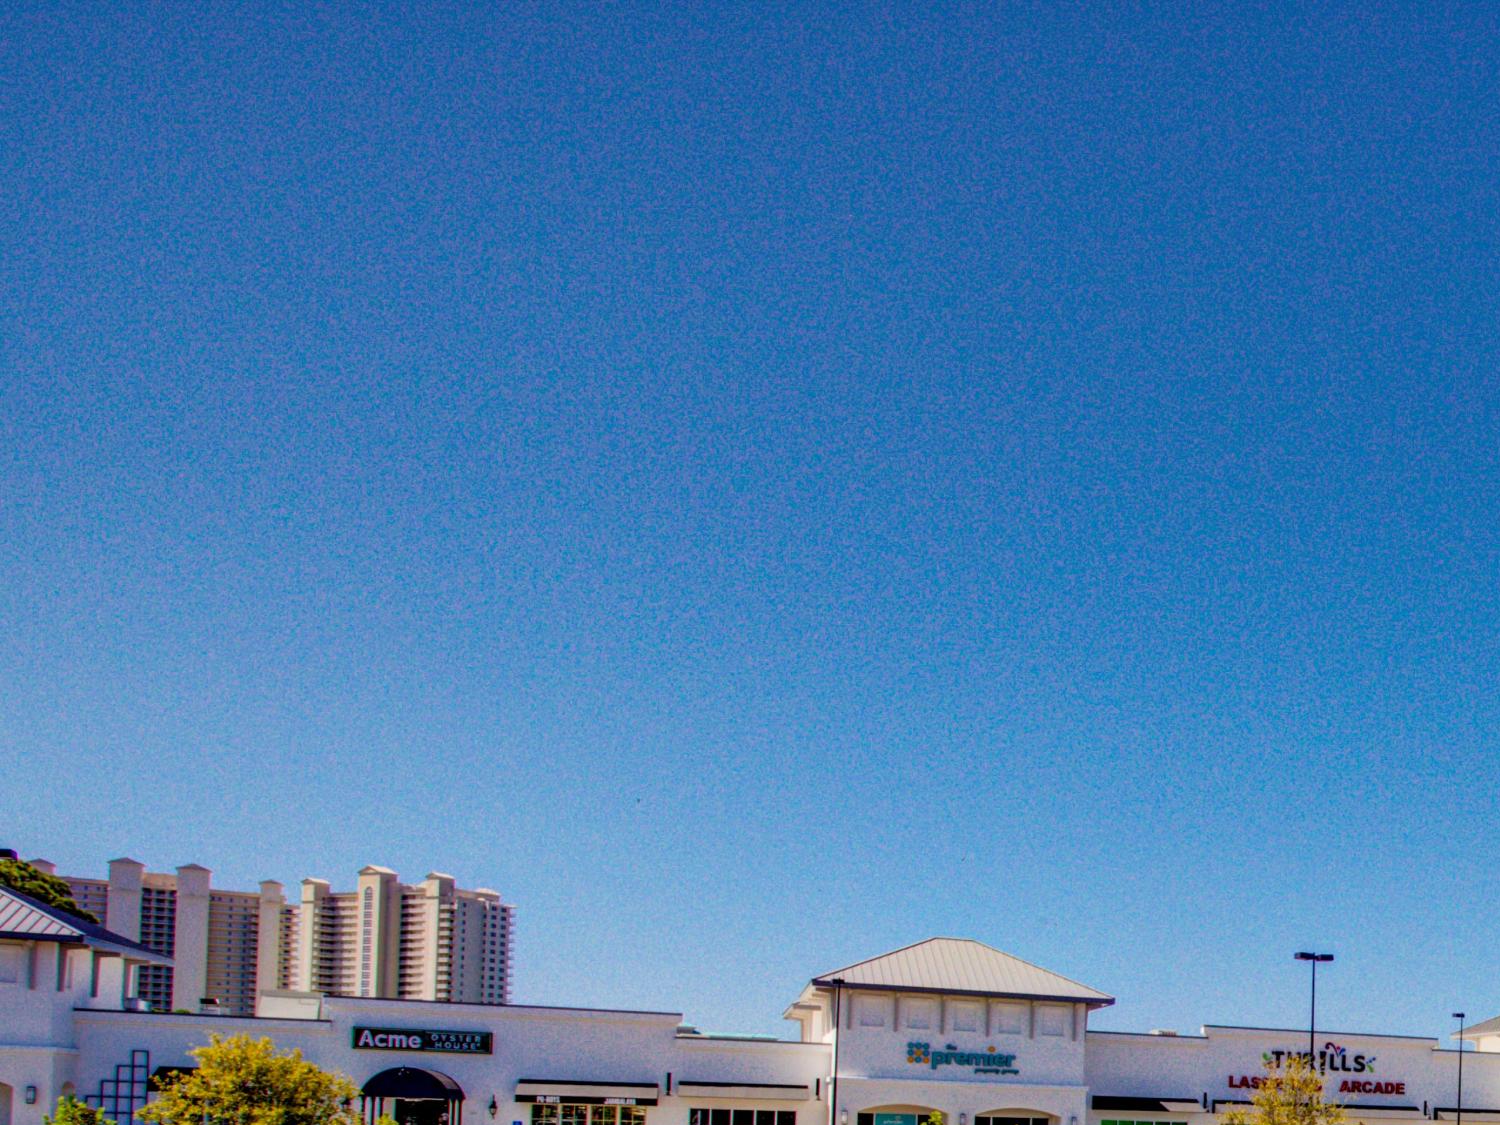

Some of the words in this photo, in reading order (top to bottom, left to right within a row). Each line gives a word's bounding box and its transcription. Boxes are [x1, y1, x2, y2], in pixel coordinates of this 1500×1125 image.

[358, 1029, 422, 1049] Acme
[431, 1033, 481, 1042] OYSTER
[434, 1041, 476, 1049] HOUSE
[931, 1045, 1017, 1070] premier
[1339, 1080, 1406, 1095] ARCADE
